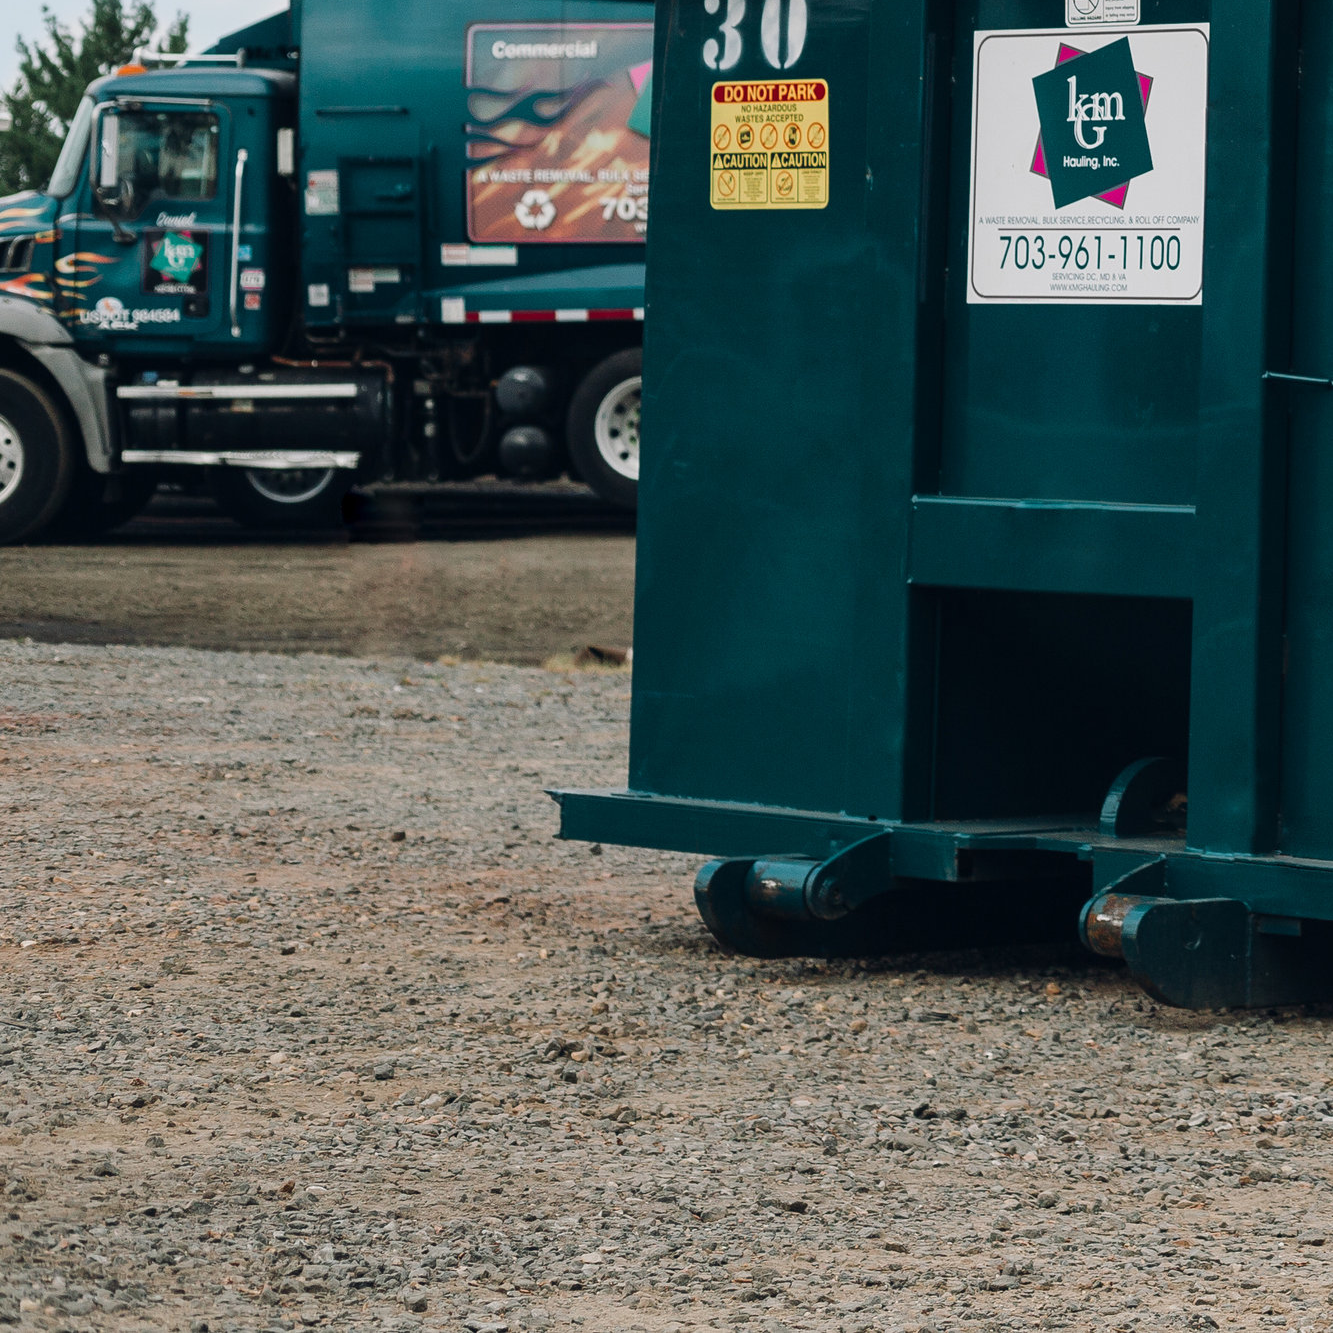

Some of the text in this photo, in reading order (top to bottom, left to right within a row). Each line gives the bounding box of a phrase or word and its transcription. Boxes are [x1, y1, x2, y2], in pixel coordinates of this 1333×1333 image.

[492, 40, 598, 59] Commercial
[724, 83, 817, 102] DO NOT PARK
[741, 104, 797, 113] NO HAZARDOUS
[735, 114, 804, 123] WASTES ACCEPTED
[723, 153, 767, 168] CAUTION
[781, 152, 826, 167] CAUTION
[1063, 155, 1120, 170] Hauling, Inc.
[978, 216, 984, 224] A
[985, 216, 1006, 224] WASTE
[1007, 216, 1040, 225] REMOVAL,
[1042, 216, 1058, 224] BULK
[1128, 216, 1134, 224] &
[1136, 216, 1150, 224] ROLL
[1152, 216, 1164, 224] OFF
[1166, 216, 1200, 224] COMPANY
[1000, 235, 1180, 271] 703-961-1100
[1050, 284, 1128, 292] WWW.KMGHAULING.COM
